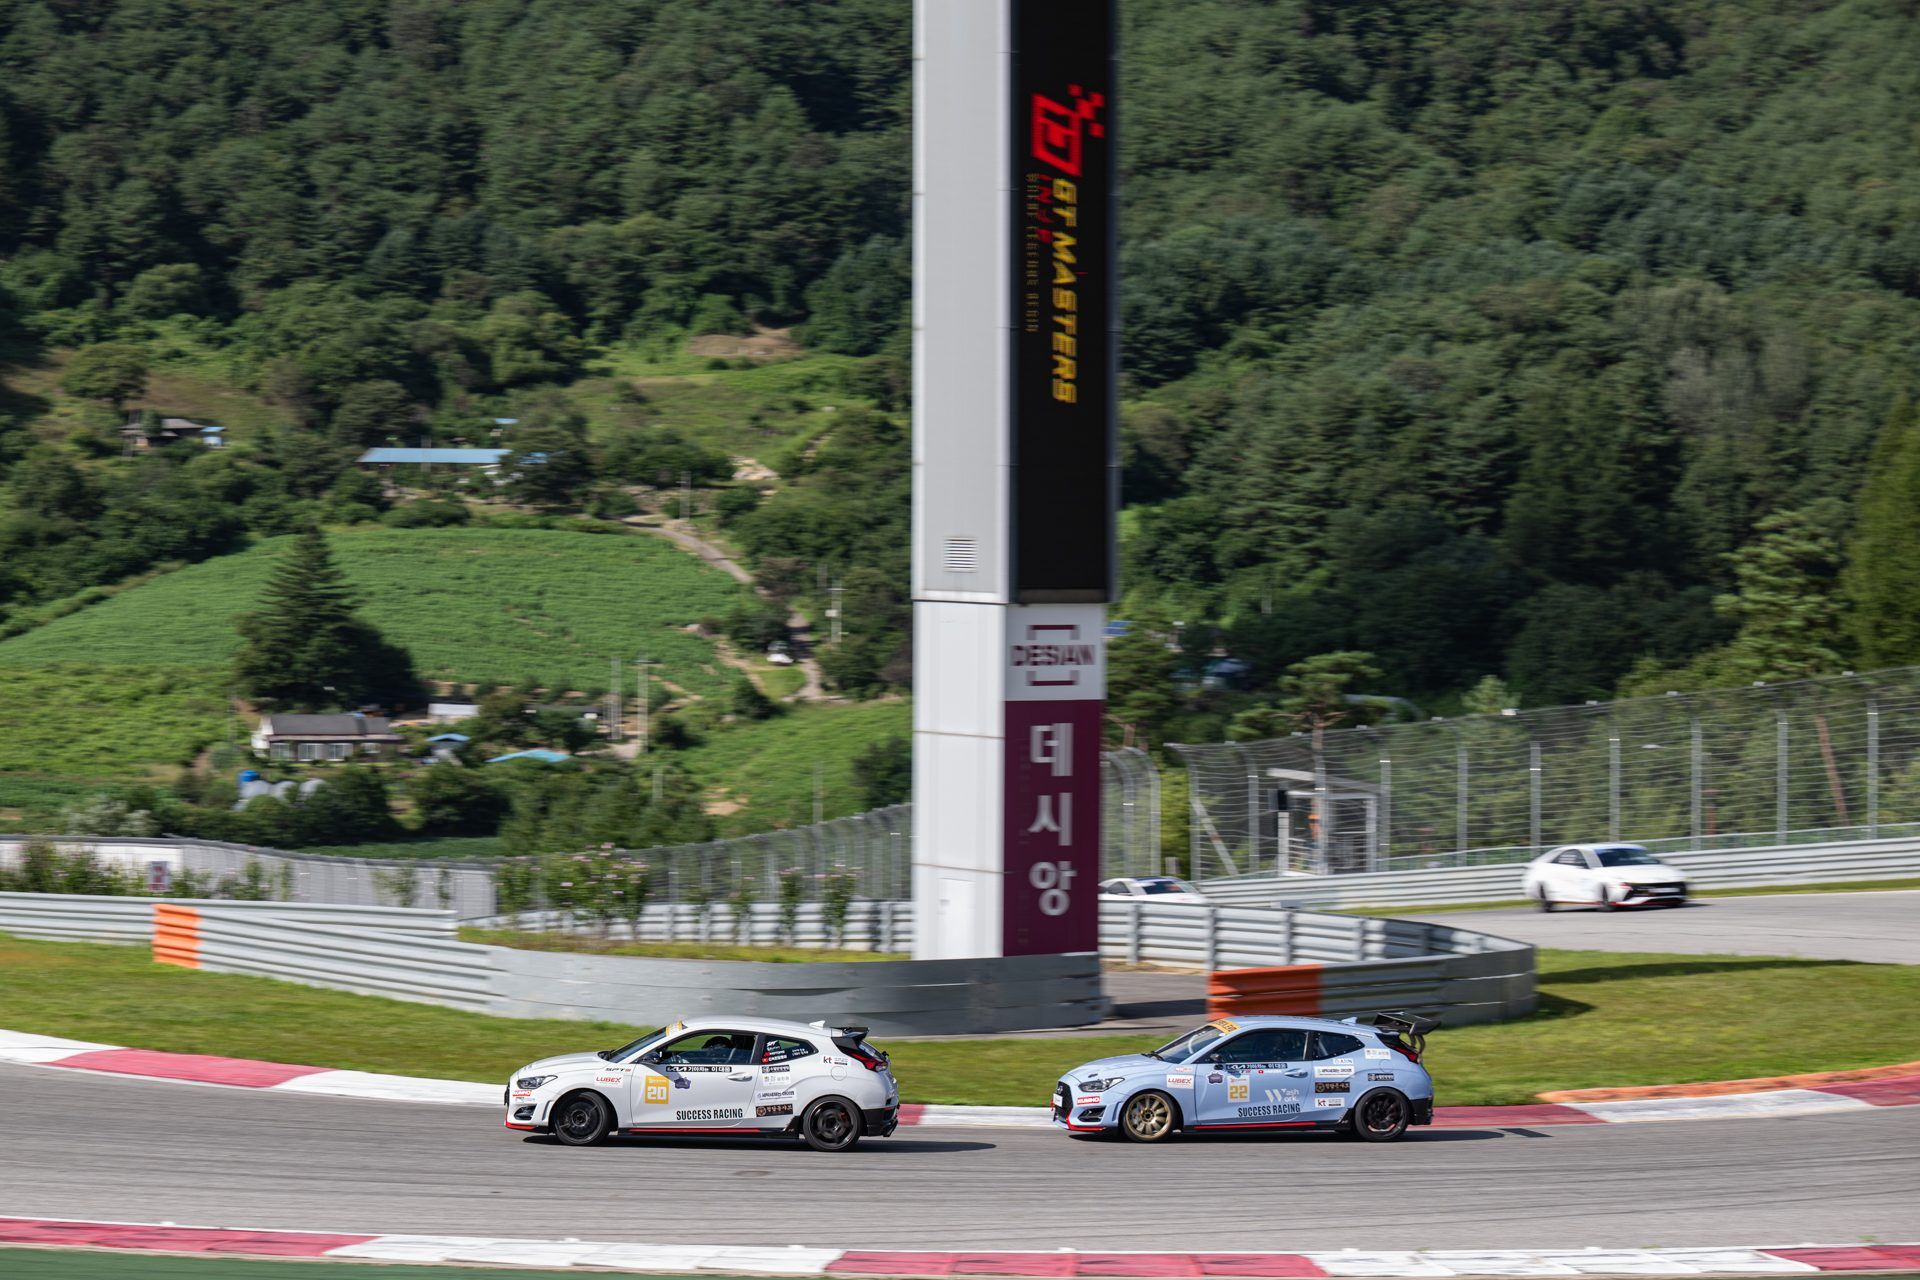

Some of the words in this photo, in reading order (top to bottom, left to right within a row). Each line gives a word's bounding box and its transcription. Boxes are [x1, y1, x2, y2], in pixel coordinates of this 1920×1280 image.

[1052, 178, 1077, 227] GT
[1052, 232, 1077, 403] MASTERS
[1028, 722, 1078, 916] 데시앙
[823, 1056, 832, 1064] kt
[647, 1086, 667, 1100] 20
[1229, 1085, 1248, 1099] 22
[676, 1109, 711, 1120] SUCCESS
[713, 1108, 743, 1119] RACING
[1238, 1105, 1271, 1117] SUCCESS
[1273, 1103, 1300, 1115] RACING
